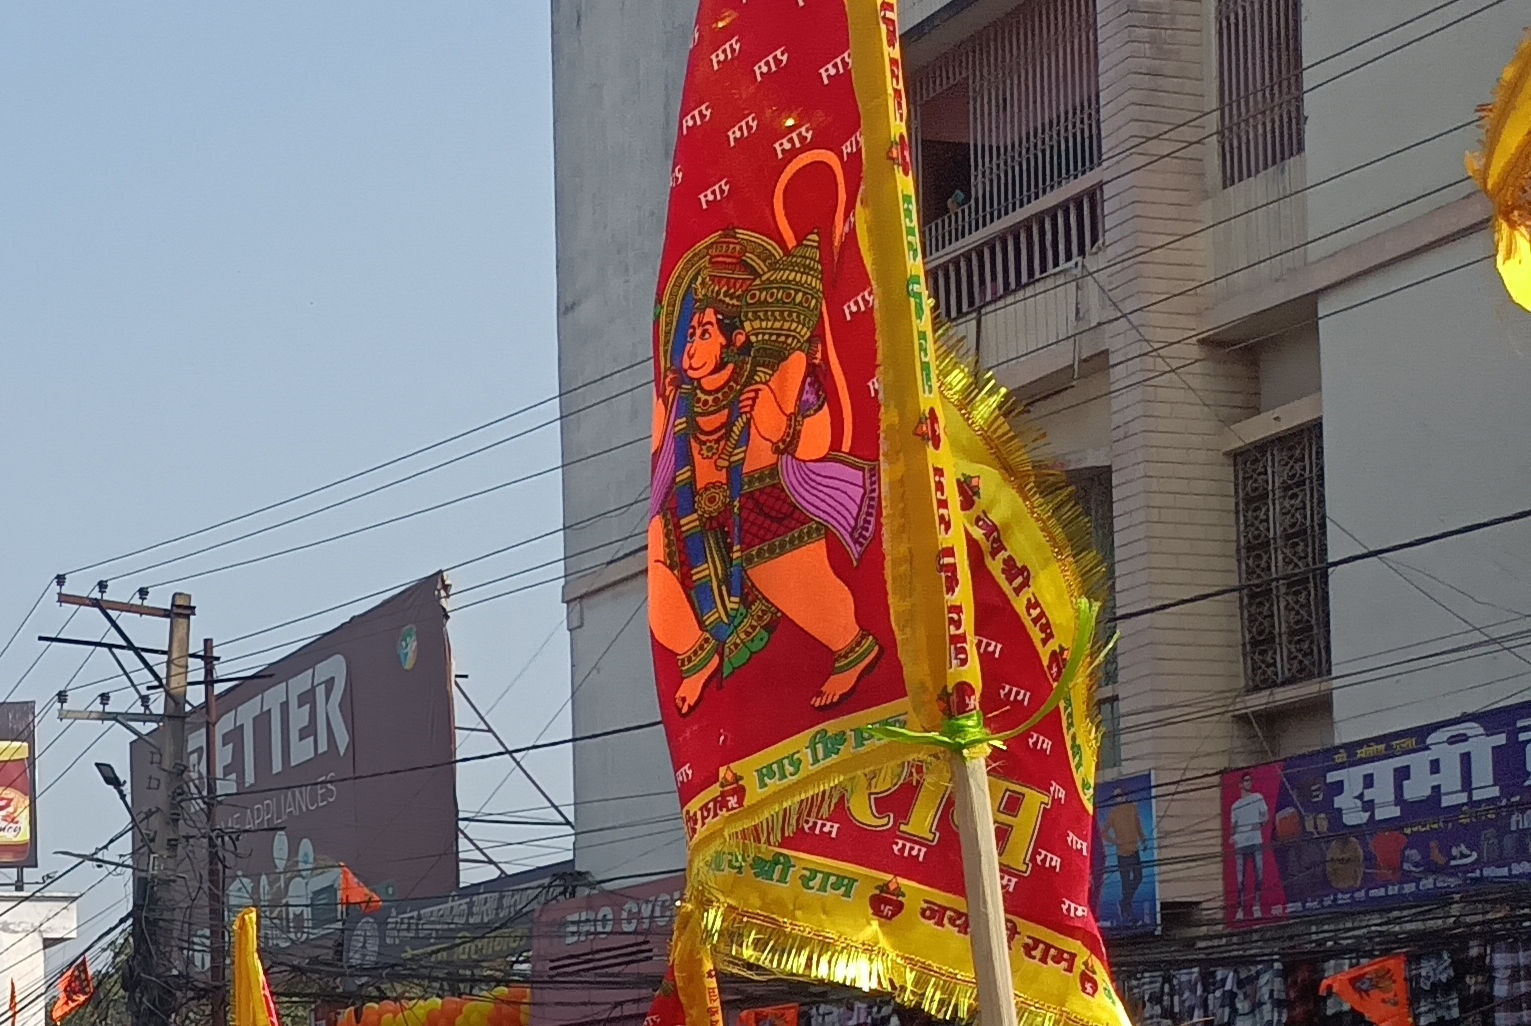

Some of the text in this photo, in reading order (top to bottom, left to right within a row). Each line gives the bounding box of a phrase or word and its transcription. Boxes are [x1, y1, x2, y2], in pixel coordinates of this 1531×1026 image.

[999, 683, 1031, 706] राम
[1028, 731, 1053, 755] राम
[803, 817, 840, 838] राम
[892, 839, 928, 862] राम
[1035, 848, 1062, 873] राम
[799, 867, 859, 899] राम
[1021, 935, 1078, 974] राम
